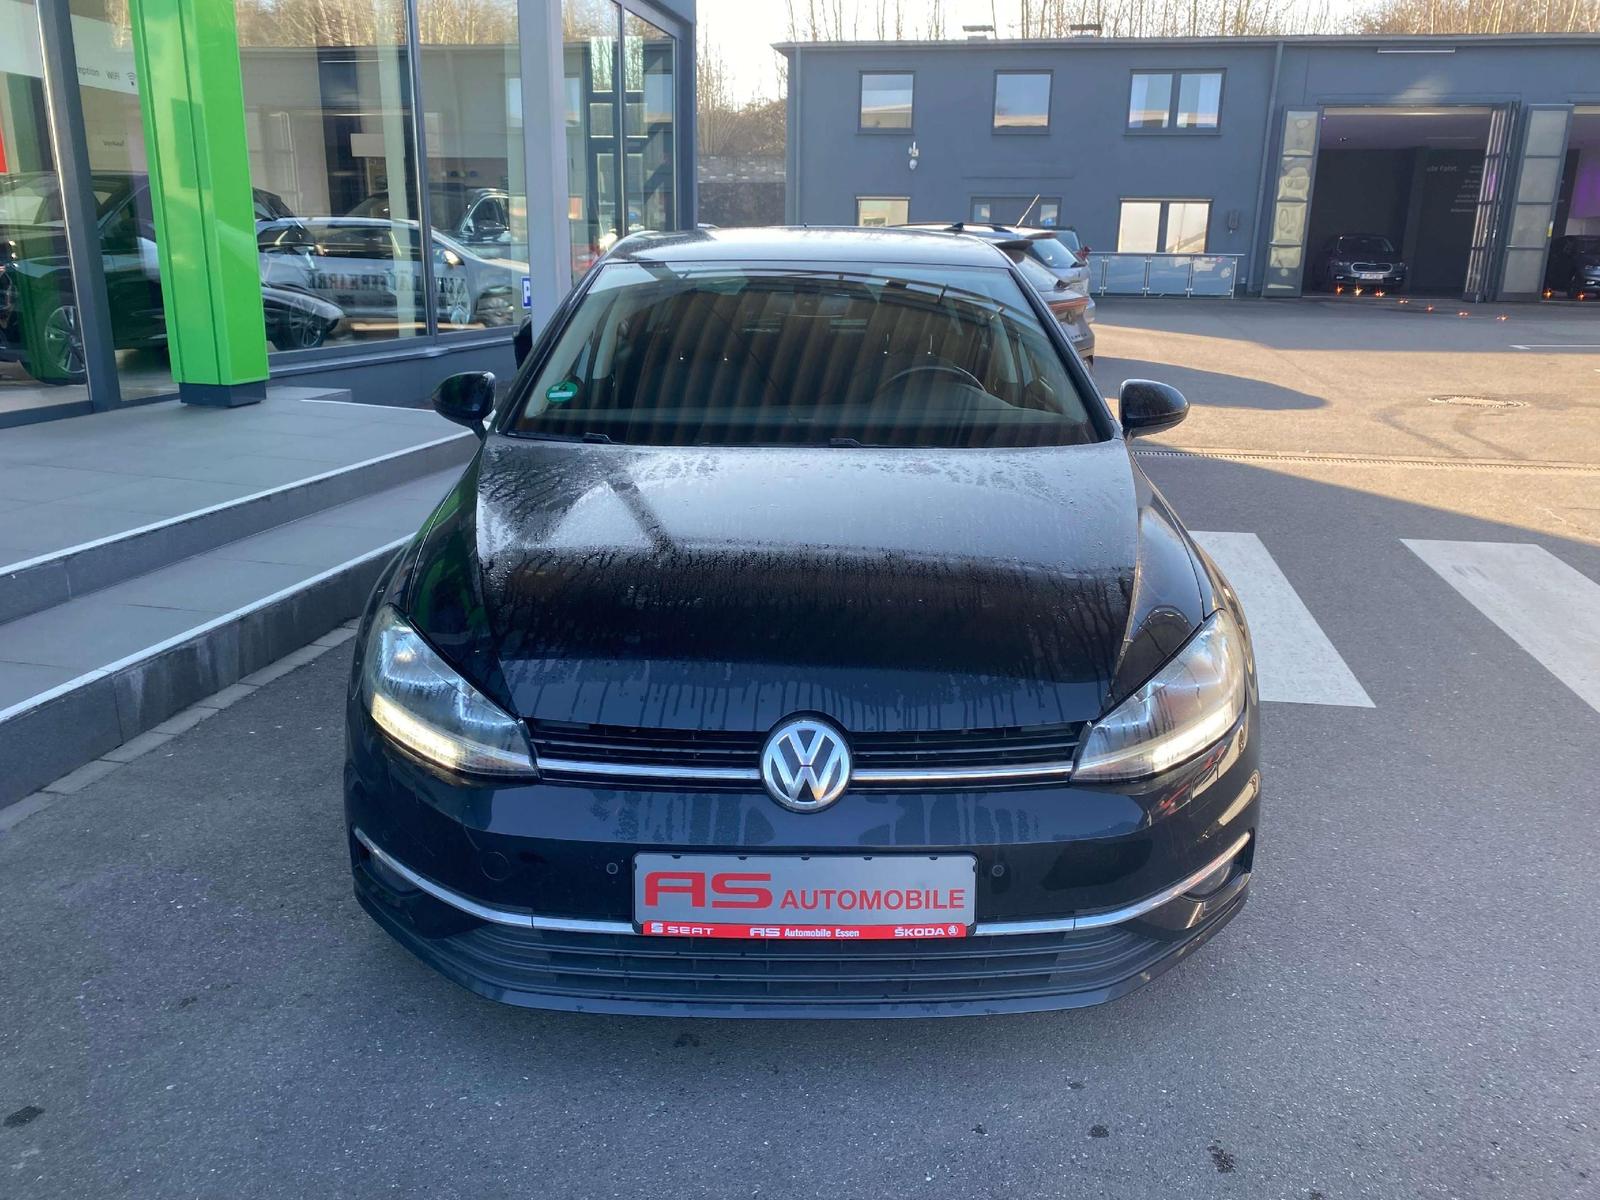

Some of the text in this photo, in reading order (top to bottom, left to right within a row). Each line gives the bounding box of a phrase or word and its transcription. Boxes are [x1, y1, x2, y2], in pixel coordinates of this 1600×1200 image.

[766, 723, 848, 807] VW
[644, 871, 966, 910] AS AUTOMOBILE
[667, 926, 714, 935] SEAT
[750, 927, 860, 937] AS Automobile Essen
[894, 926, 945, 937] ŠKODA
